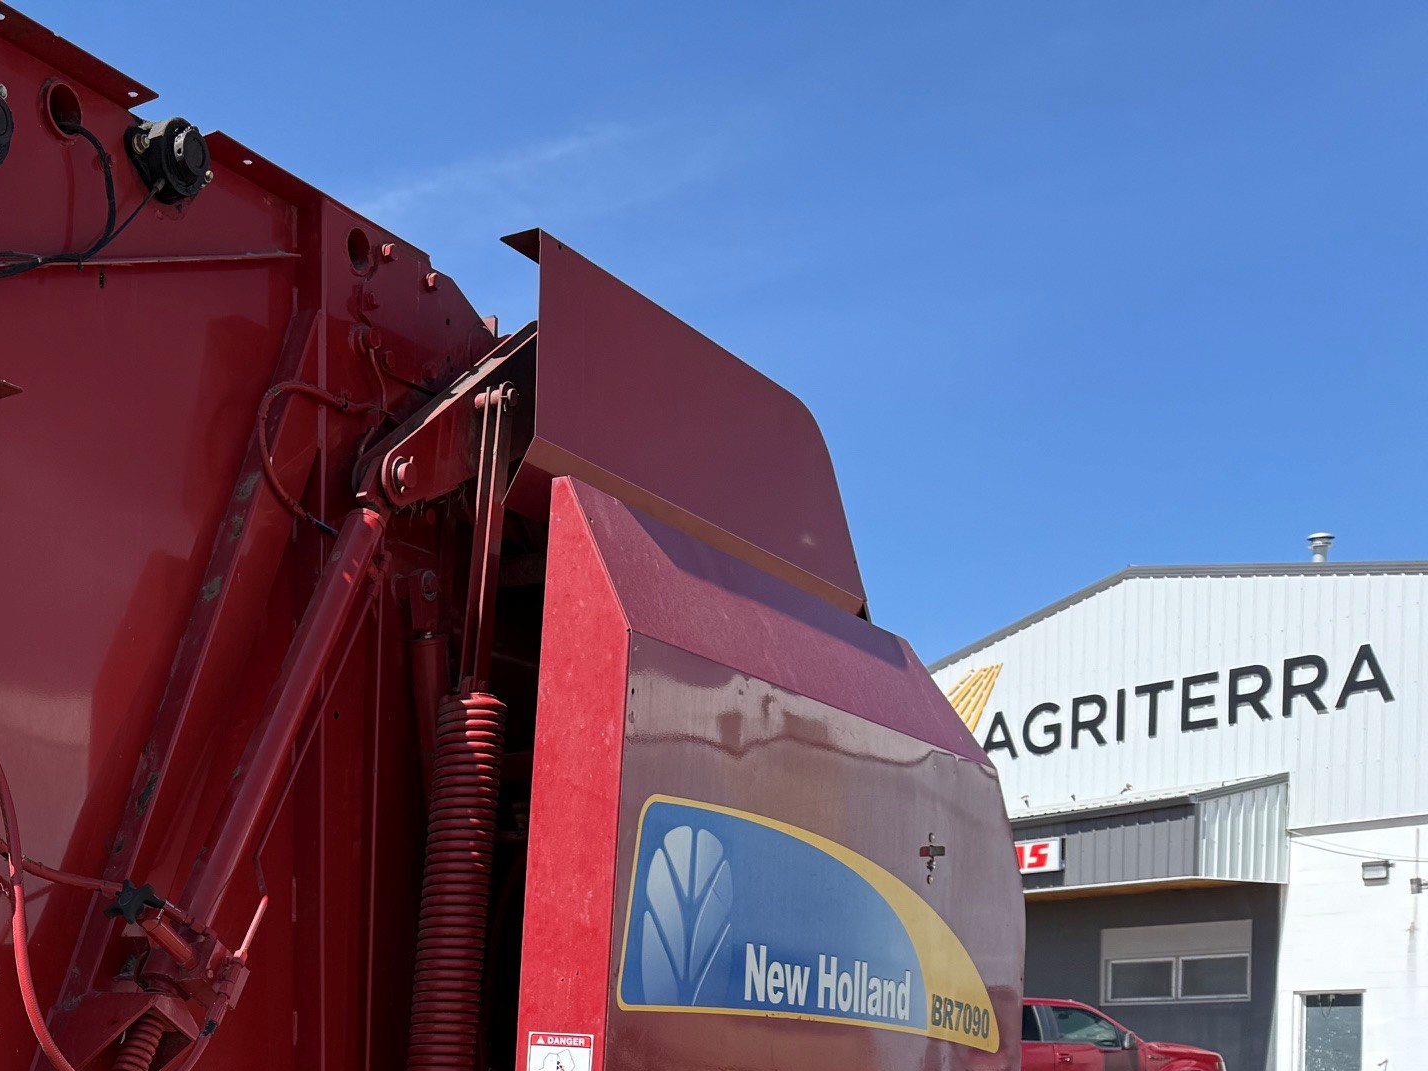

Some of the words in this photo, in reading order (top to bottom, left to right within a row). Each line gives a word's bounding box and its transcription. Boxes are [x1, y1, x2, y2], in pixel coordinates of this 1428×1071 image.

[984, 643, 1395, 759] AGRITERRA
[744, 942, 811, 1007] New
[817, 953, 911, 1021] Holland
[547, 1036, 585, 1046] DANGER
[931, 993, 990, 1039] BR7090
